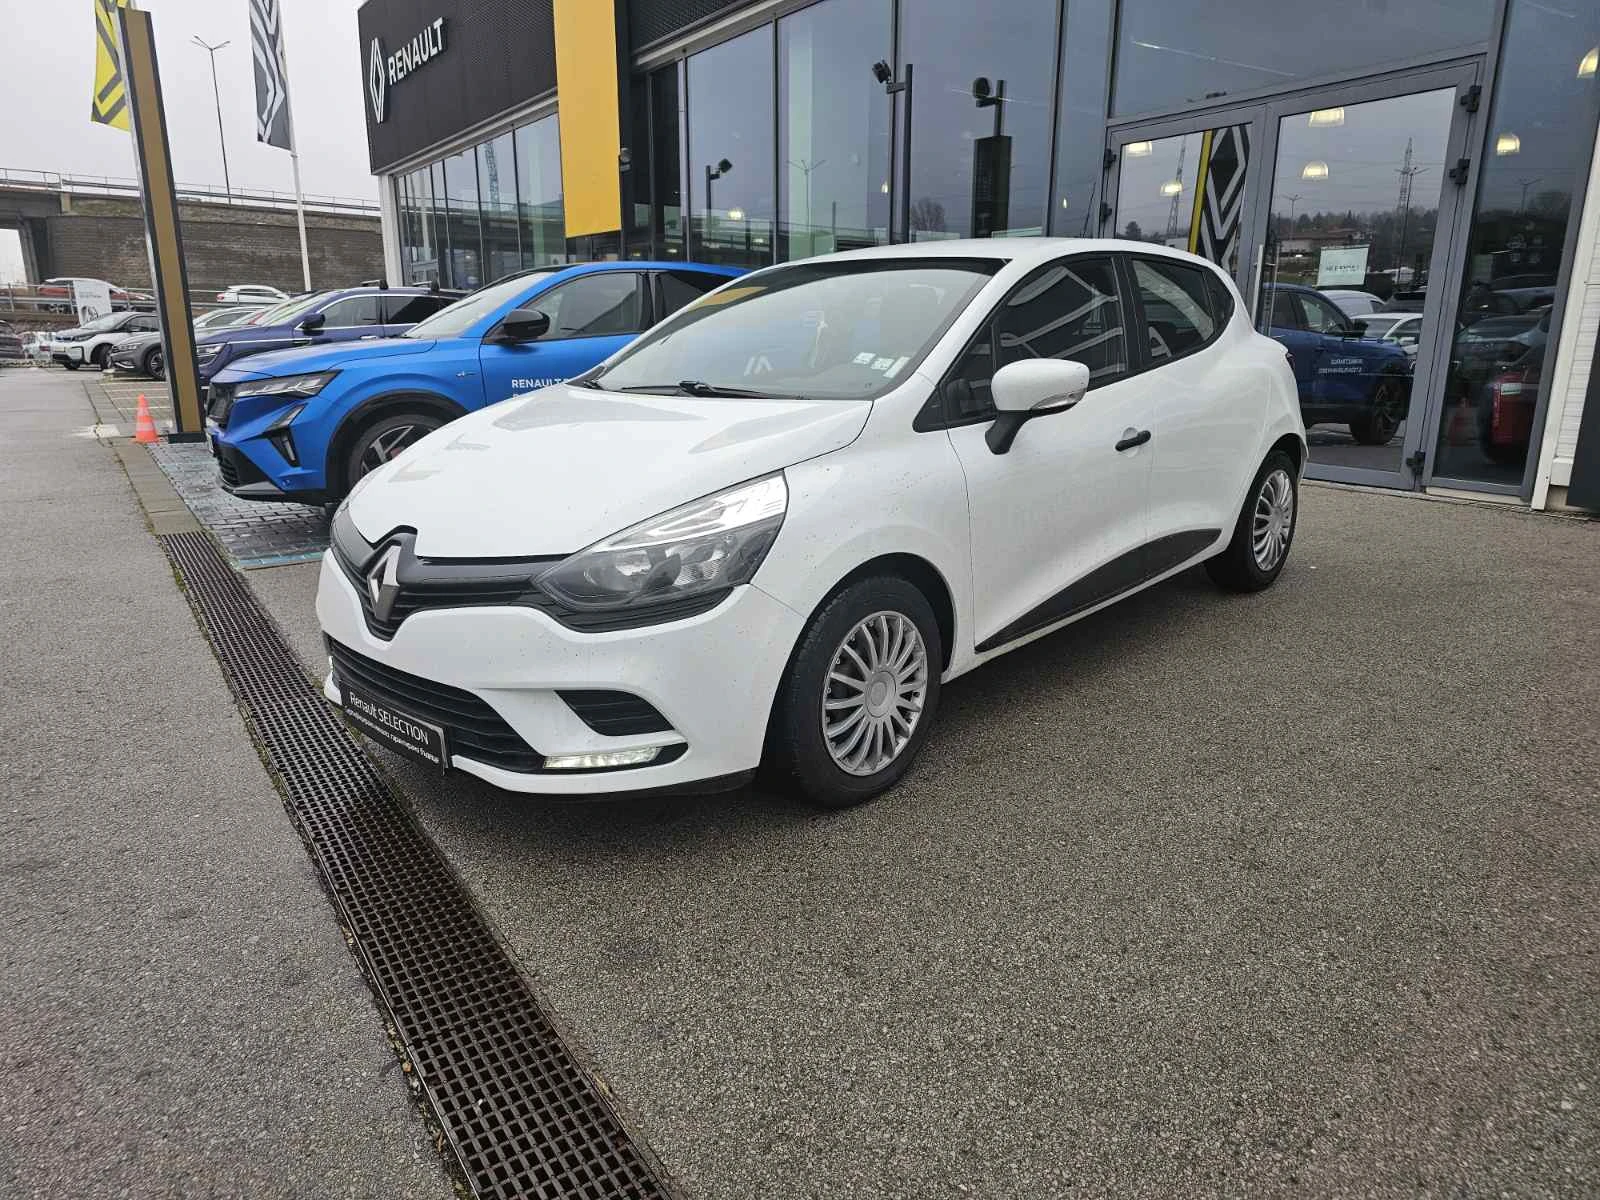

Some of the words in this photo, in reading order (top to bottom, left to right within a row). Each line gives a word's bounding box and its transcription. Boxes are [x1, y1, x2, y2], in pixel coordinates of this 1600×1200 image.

[387, 16, 443, 85] RENAULT
[350, 691, 377, 719] Renault
[378, 708, 429, 745] SELECTION
